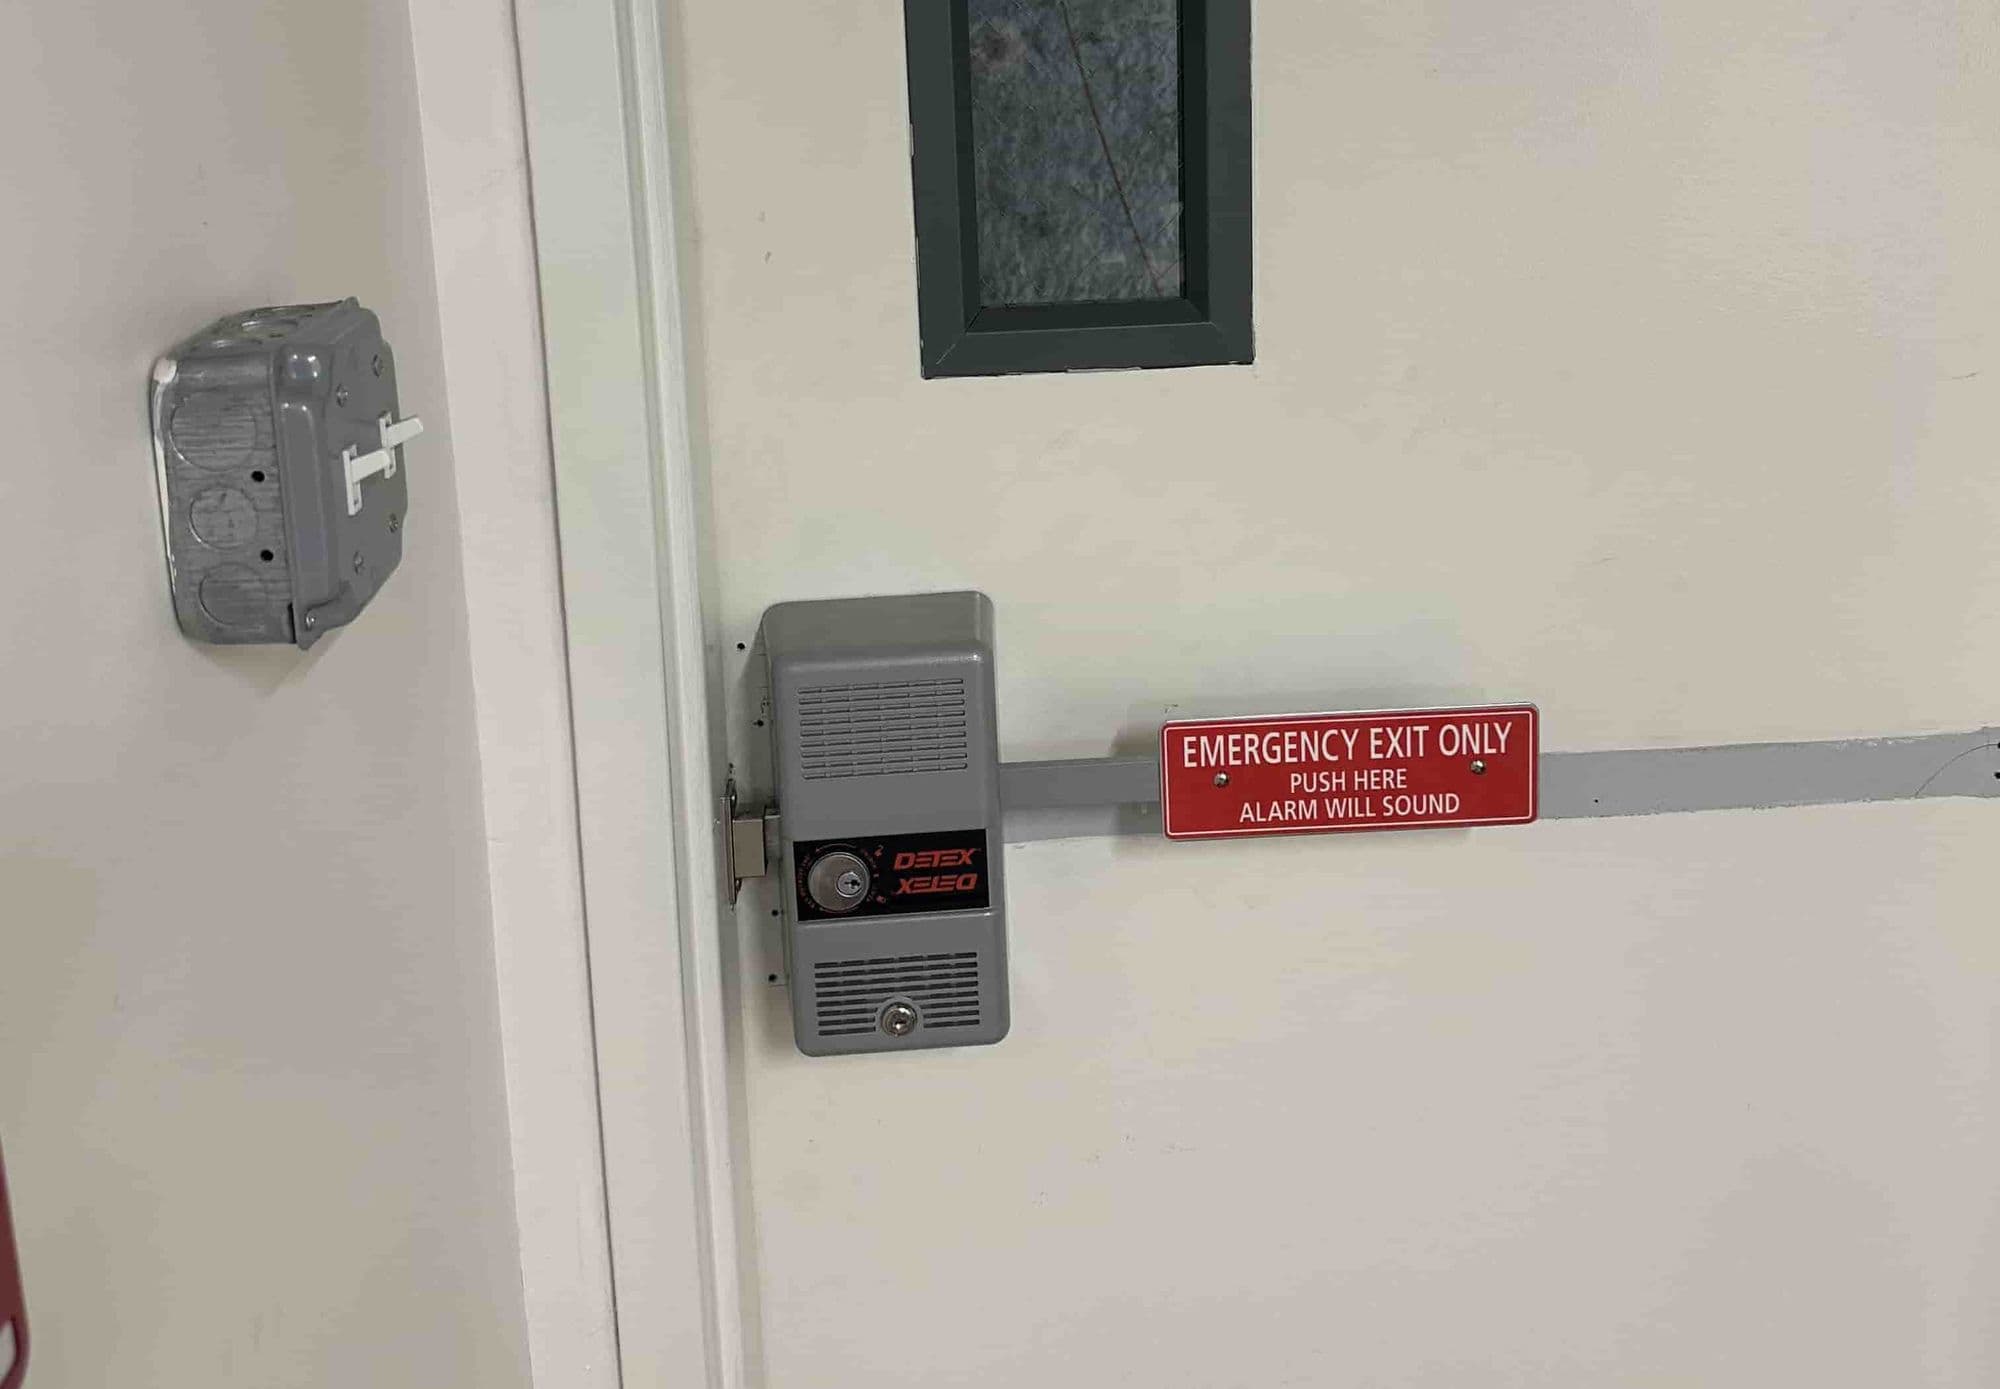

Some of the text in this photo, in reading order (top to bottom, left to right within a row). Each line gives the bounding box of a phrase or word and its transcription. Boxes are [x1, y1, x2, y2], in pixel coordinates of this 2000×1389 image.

[1183, 721, 1513, 768] EMERGENCY EXIT ONLY
[1290, 768, 1408, 794] PUSH HERE
[1239, 793, 1460, 823] ALARM WILL SOUND
[894, 848, 980, 870] DETEX
